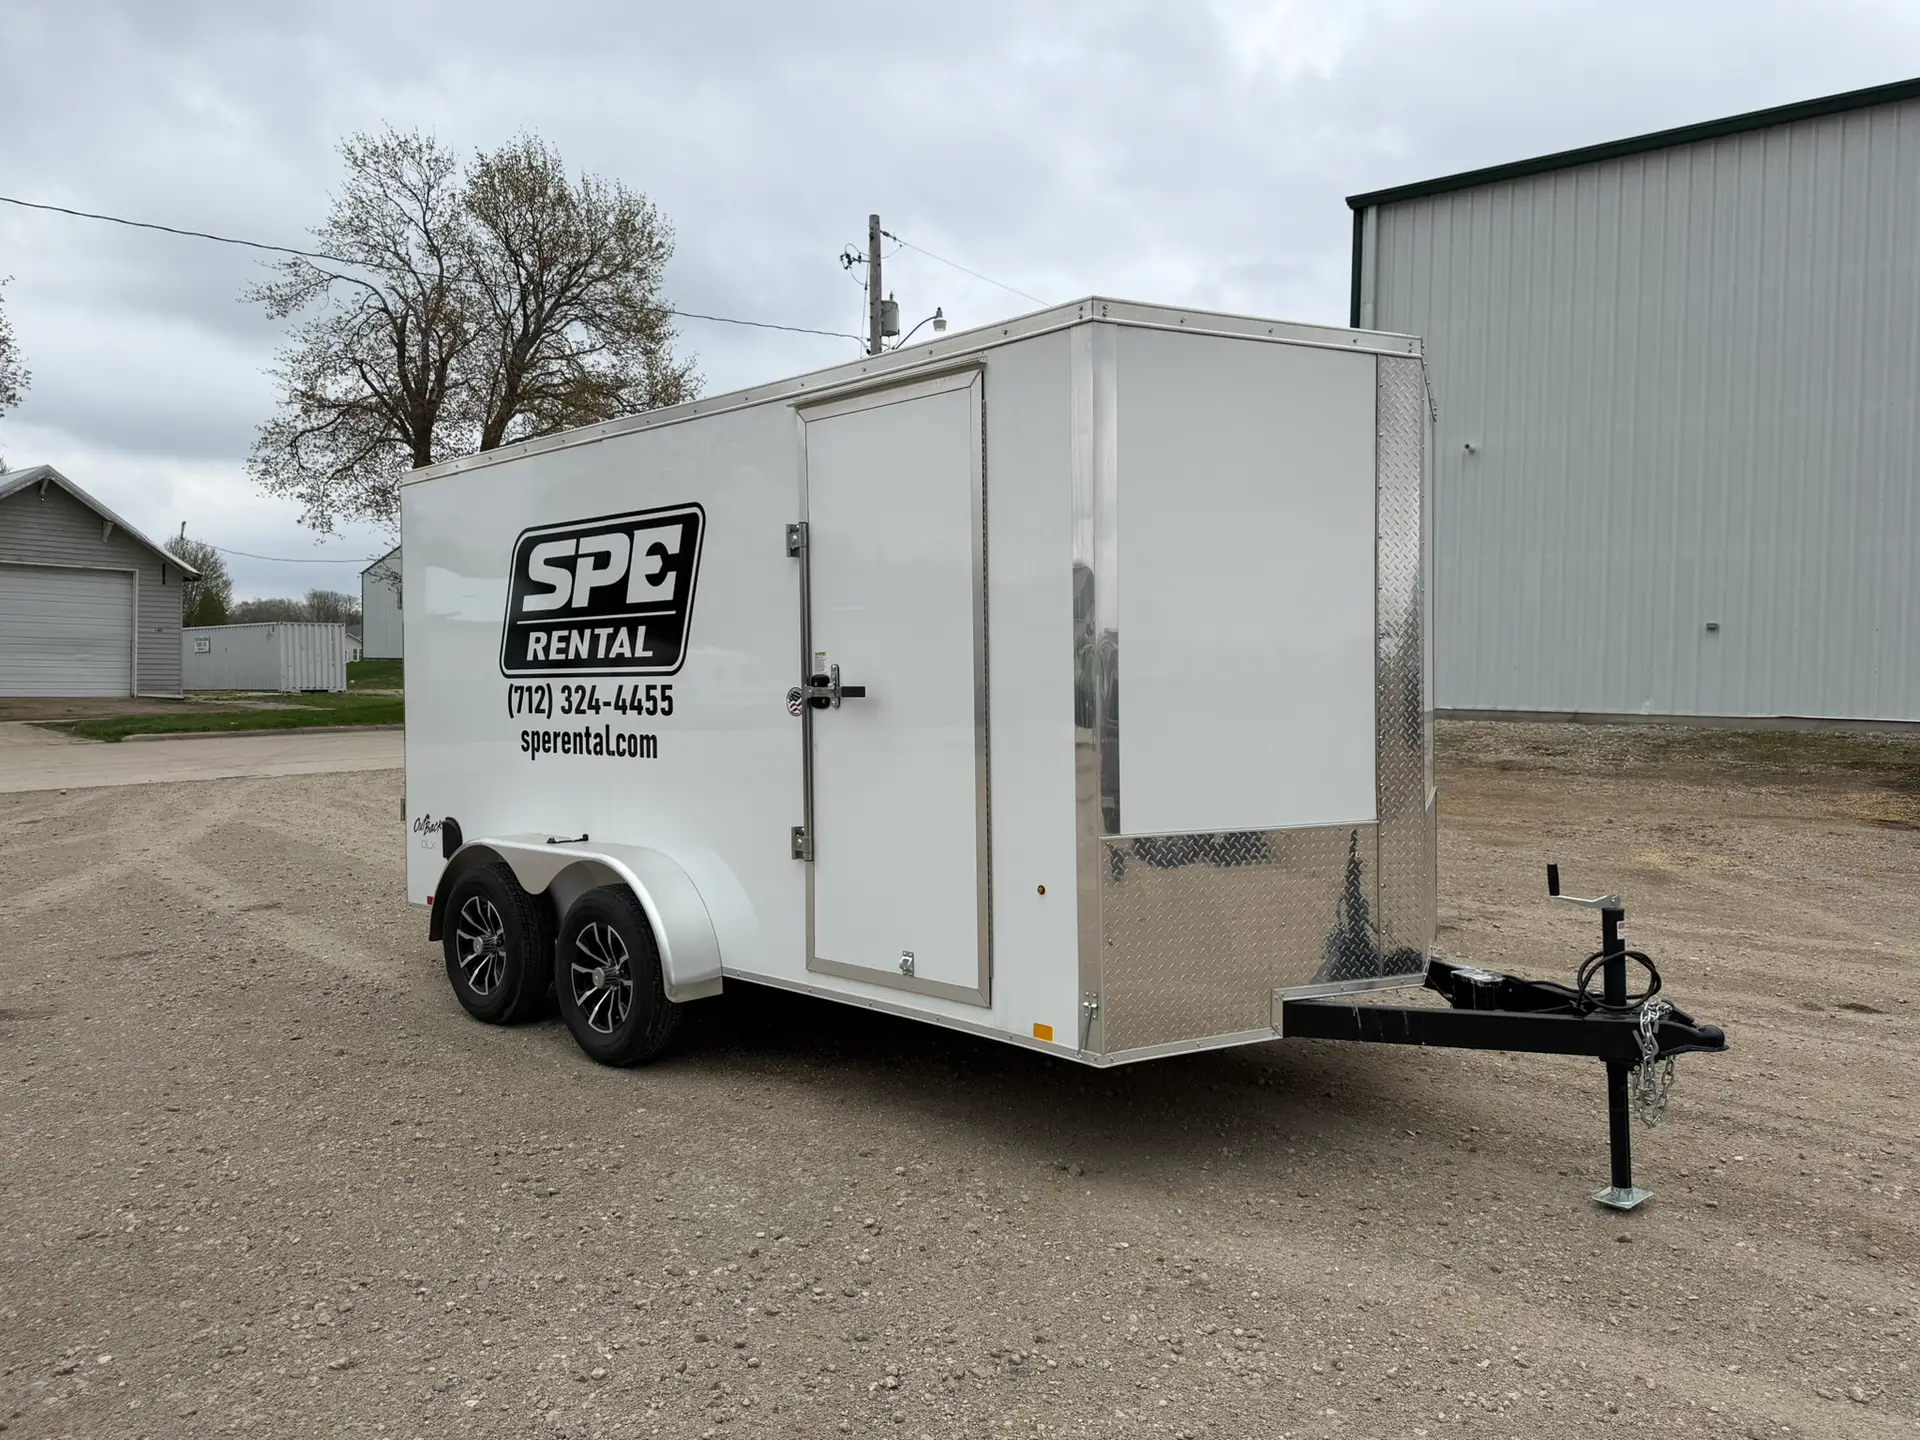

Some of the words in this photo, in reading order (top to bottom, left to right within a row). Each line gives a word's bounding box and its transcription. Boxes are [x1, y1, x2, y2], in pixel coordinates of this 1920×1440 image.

[522, 524, 684, 612] SPE
[527, 625, 653, 661] RENTAL
[507, 683, 552, 719] (712)
[560, 684, 673, 717] 324-4455
[521, 724, 658, 760] sperental.com
